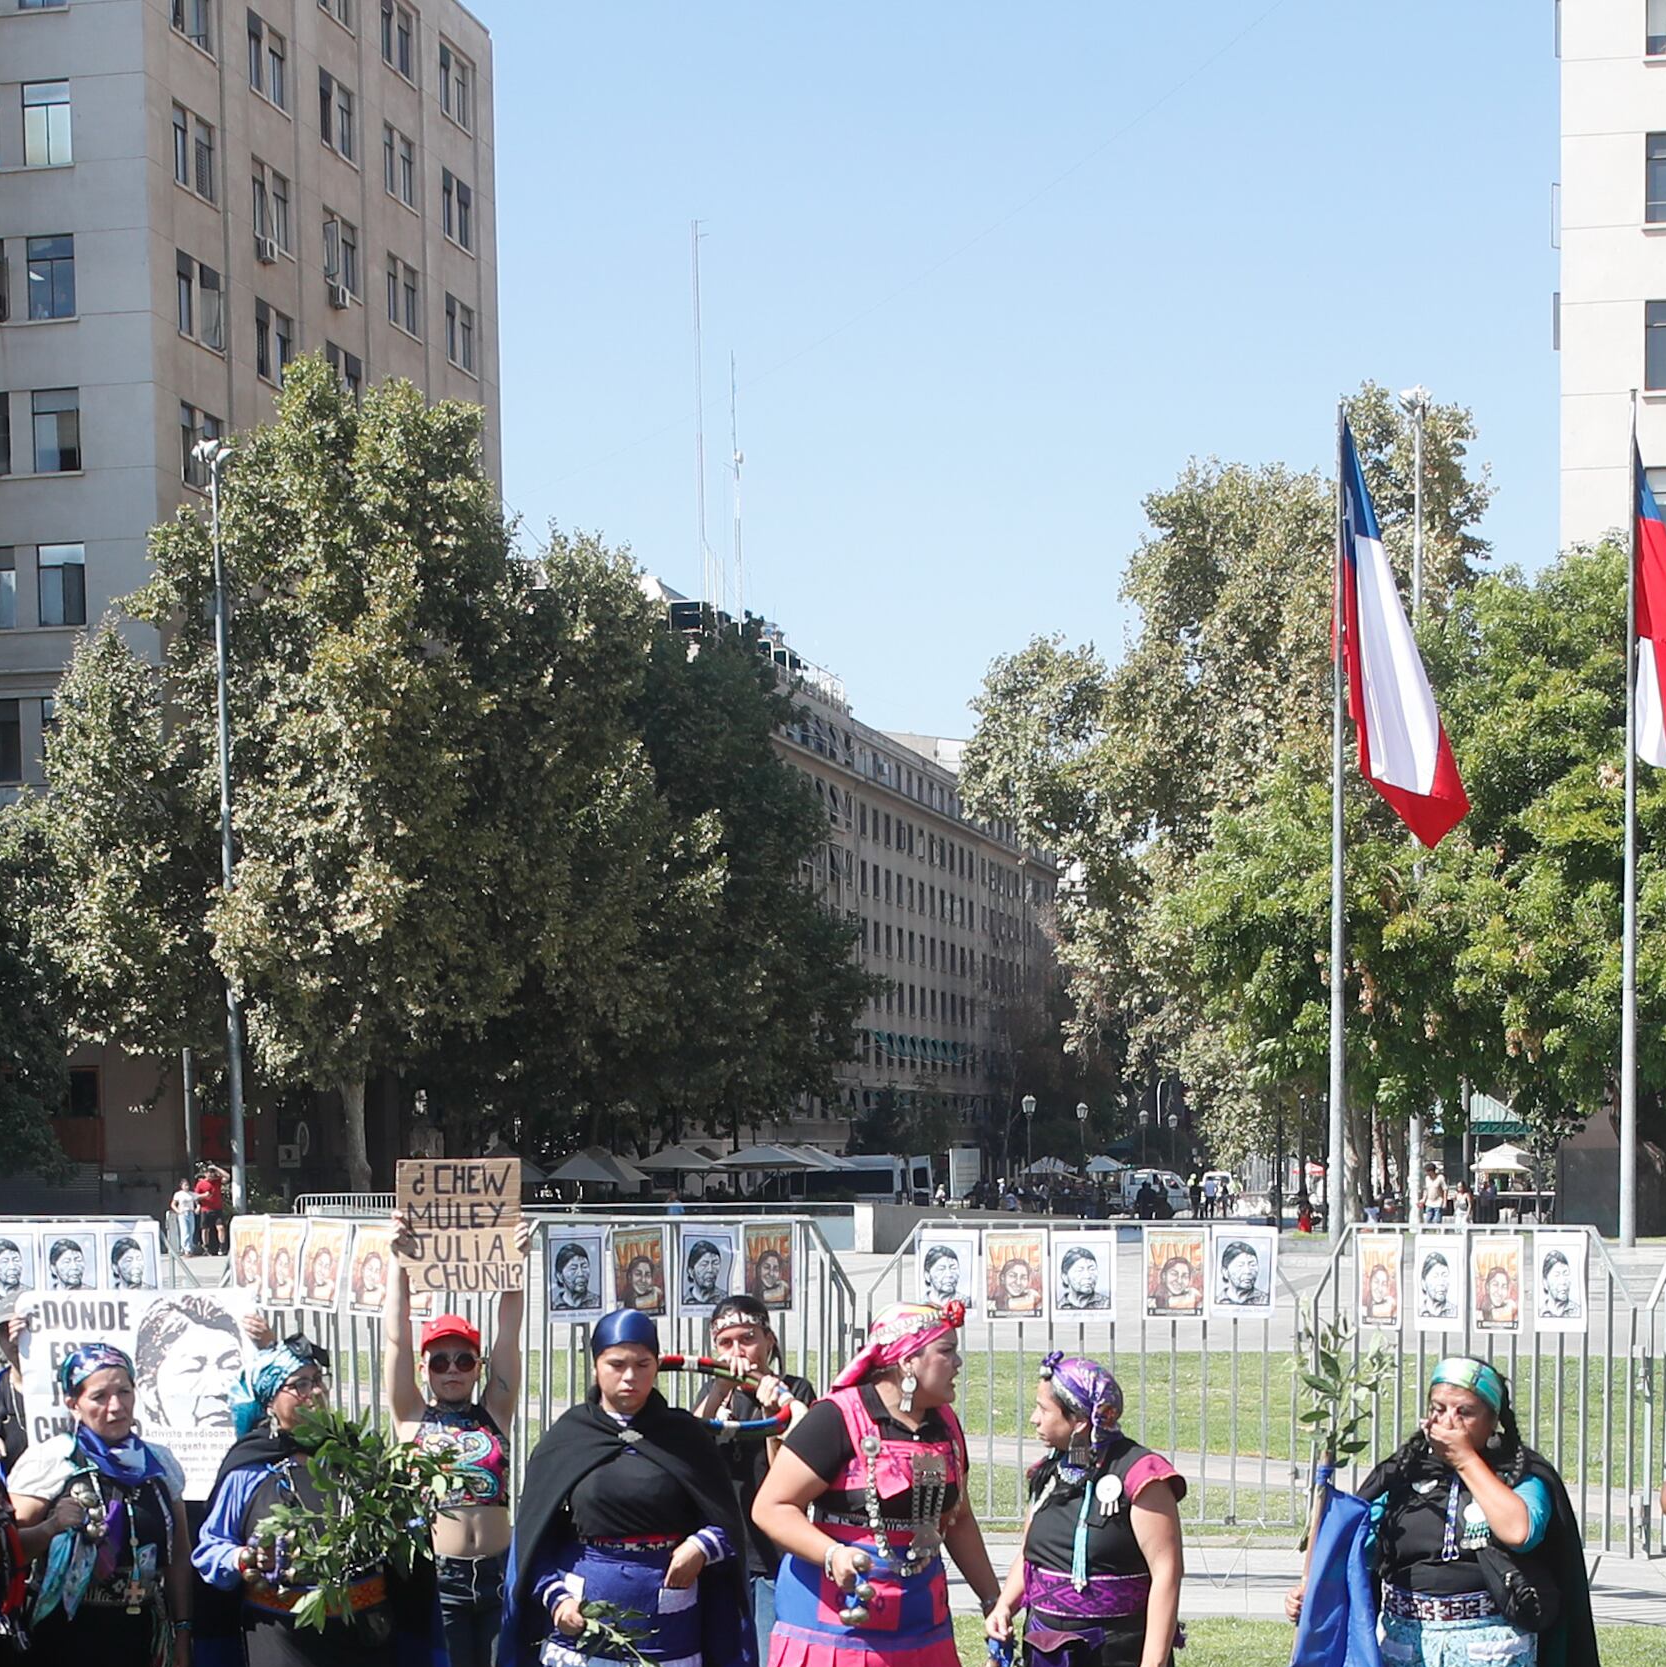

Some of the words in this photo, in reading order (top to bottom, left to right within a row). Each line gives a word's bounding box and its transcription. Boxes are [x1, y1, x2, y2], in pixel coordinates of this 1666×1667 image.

[616, 1239, 661, 1265] VIVE
[747, 1232, 790, 1260] VIVE
[989, 1243, 1040, 1269] VIVE
[1150, 1243, 1202, 1269] VIVE
[28, 1295, 131, 1333] ¿DÓNDE
[186, 1428, 234, 1438] medioamb
